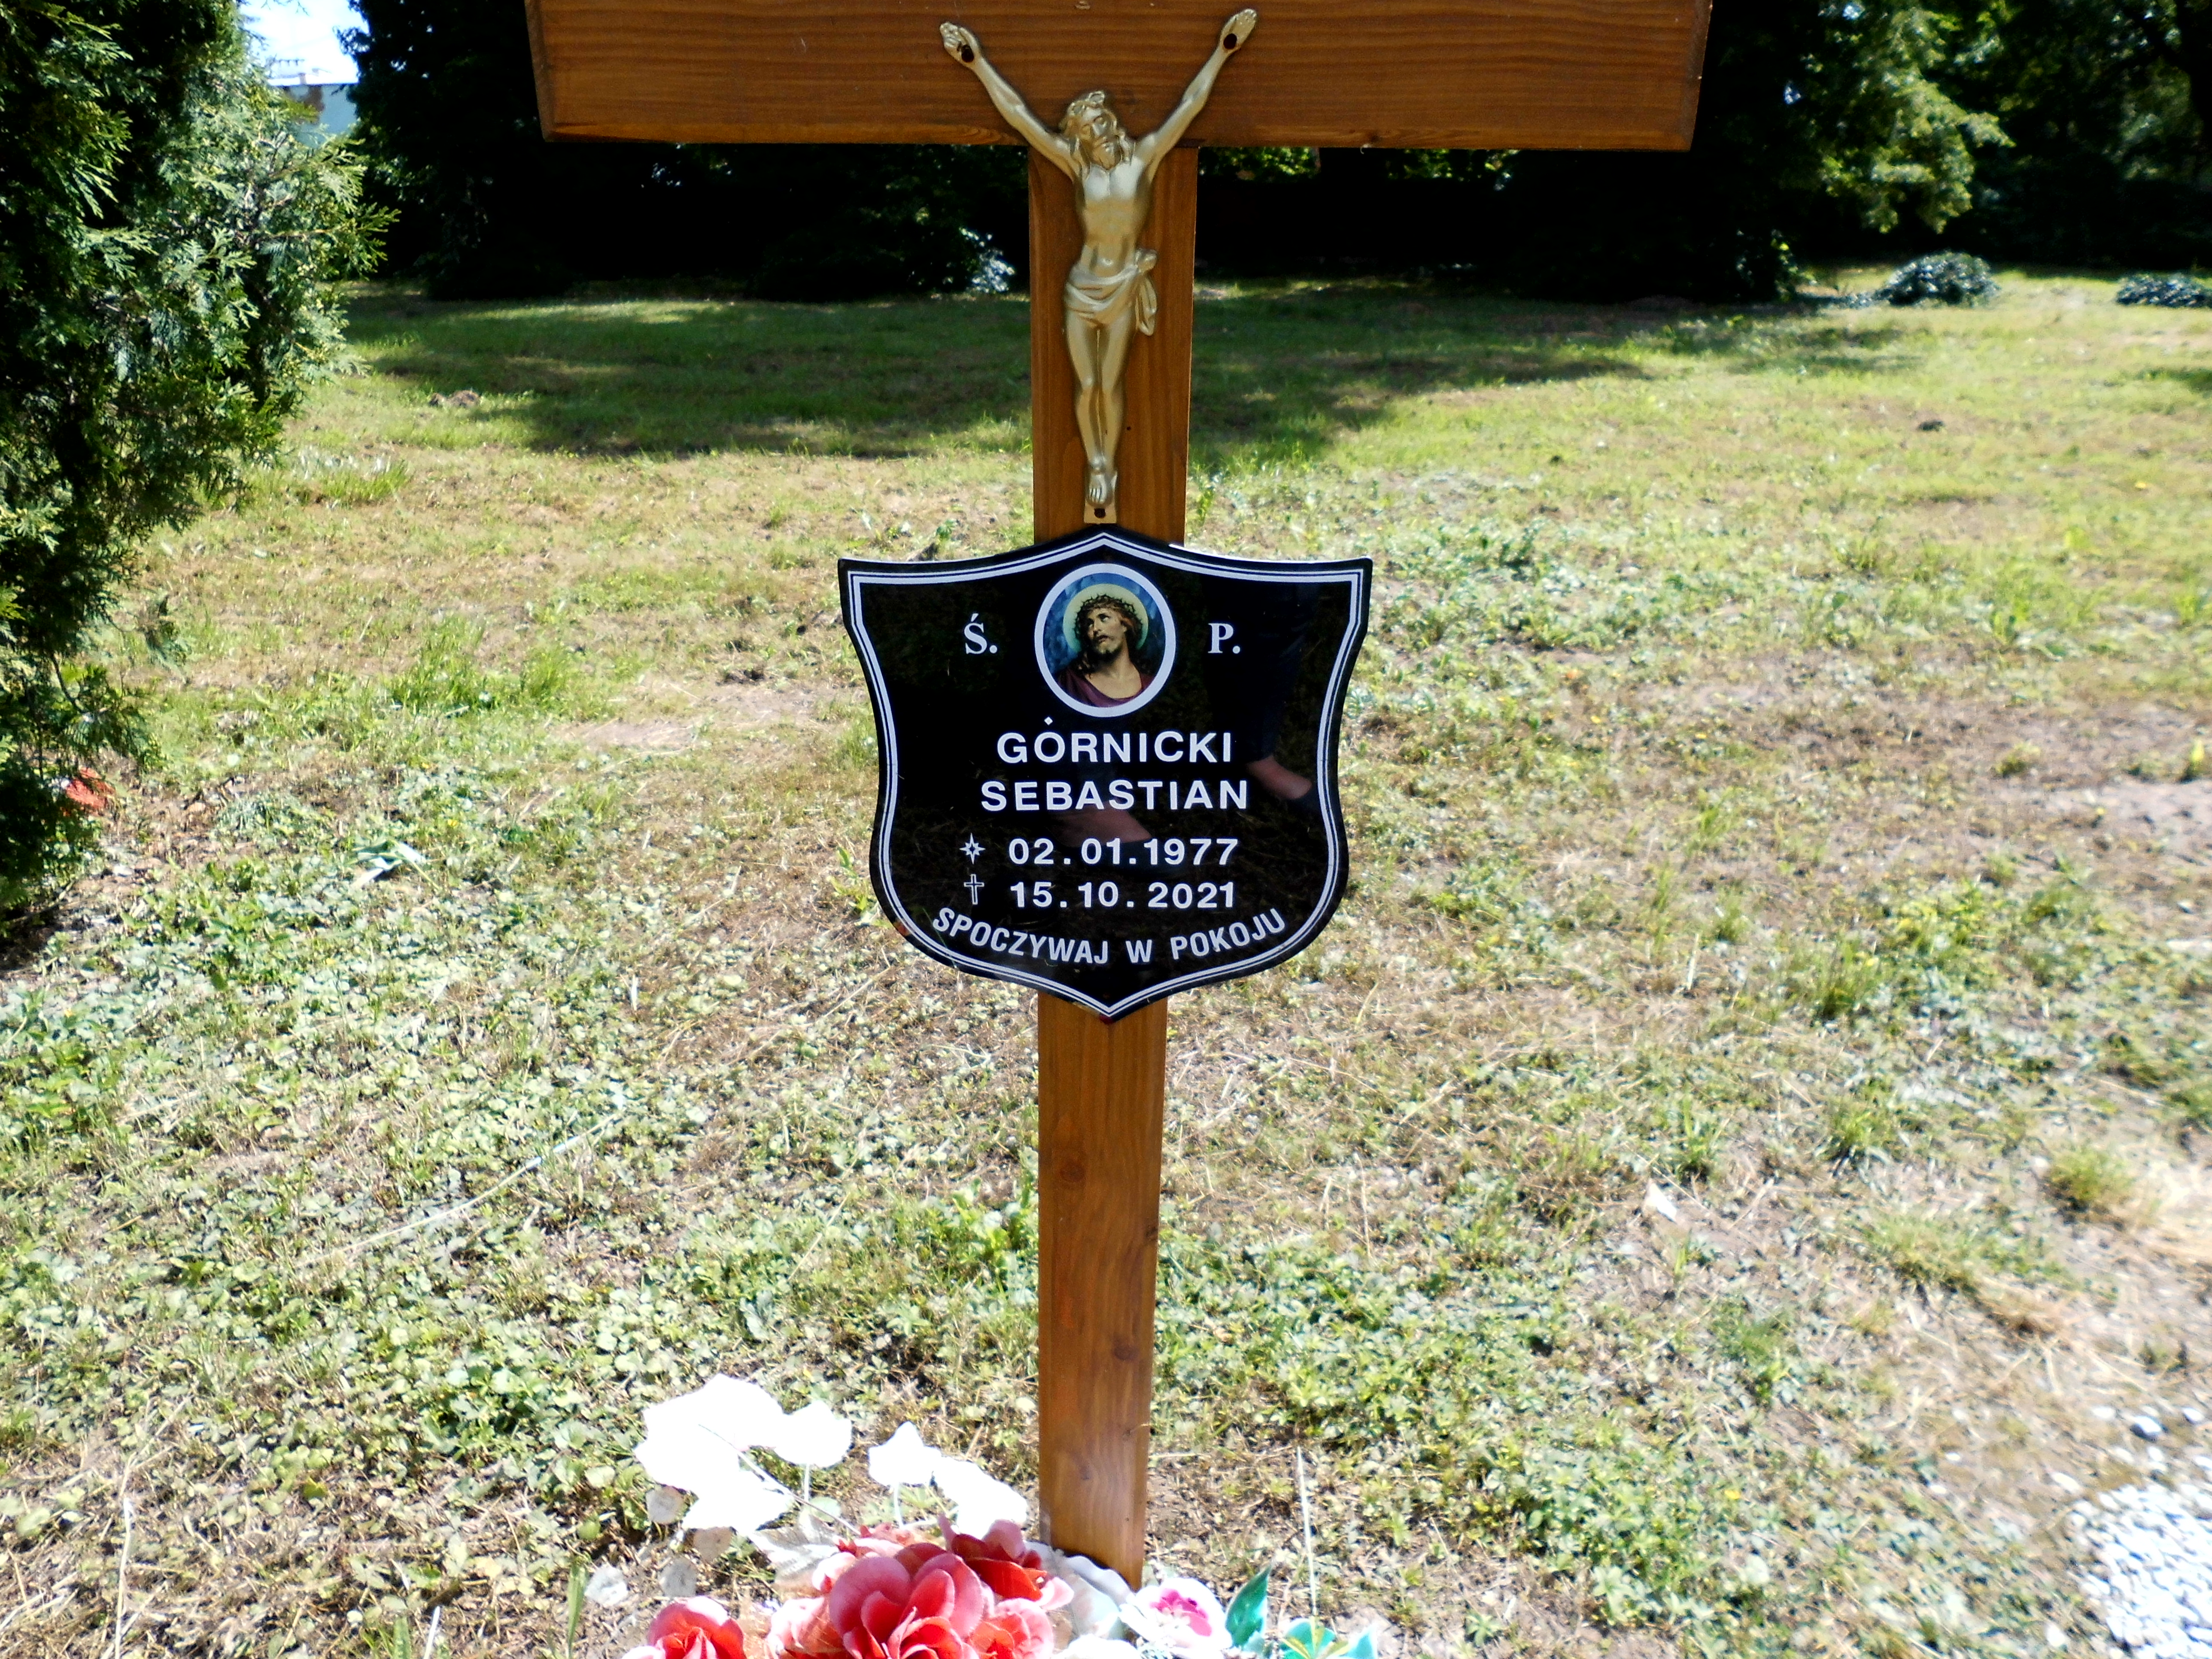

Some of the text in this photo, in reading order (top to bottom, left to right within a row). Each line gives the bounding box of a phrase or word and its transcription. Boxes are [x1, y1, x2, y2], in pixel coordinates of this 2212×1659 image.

[963, 613, 1241, 654] Ś. P.
[981, 779, 1248, 811] SEBASTIAN
[1008, 837, 1239, 866] 02.01.1977
[932, 907, 1286, 965] SPOCZYWAJ W POKOJU
